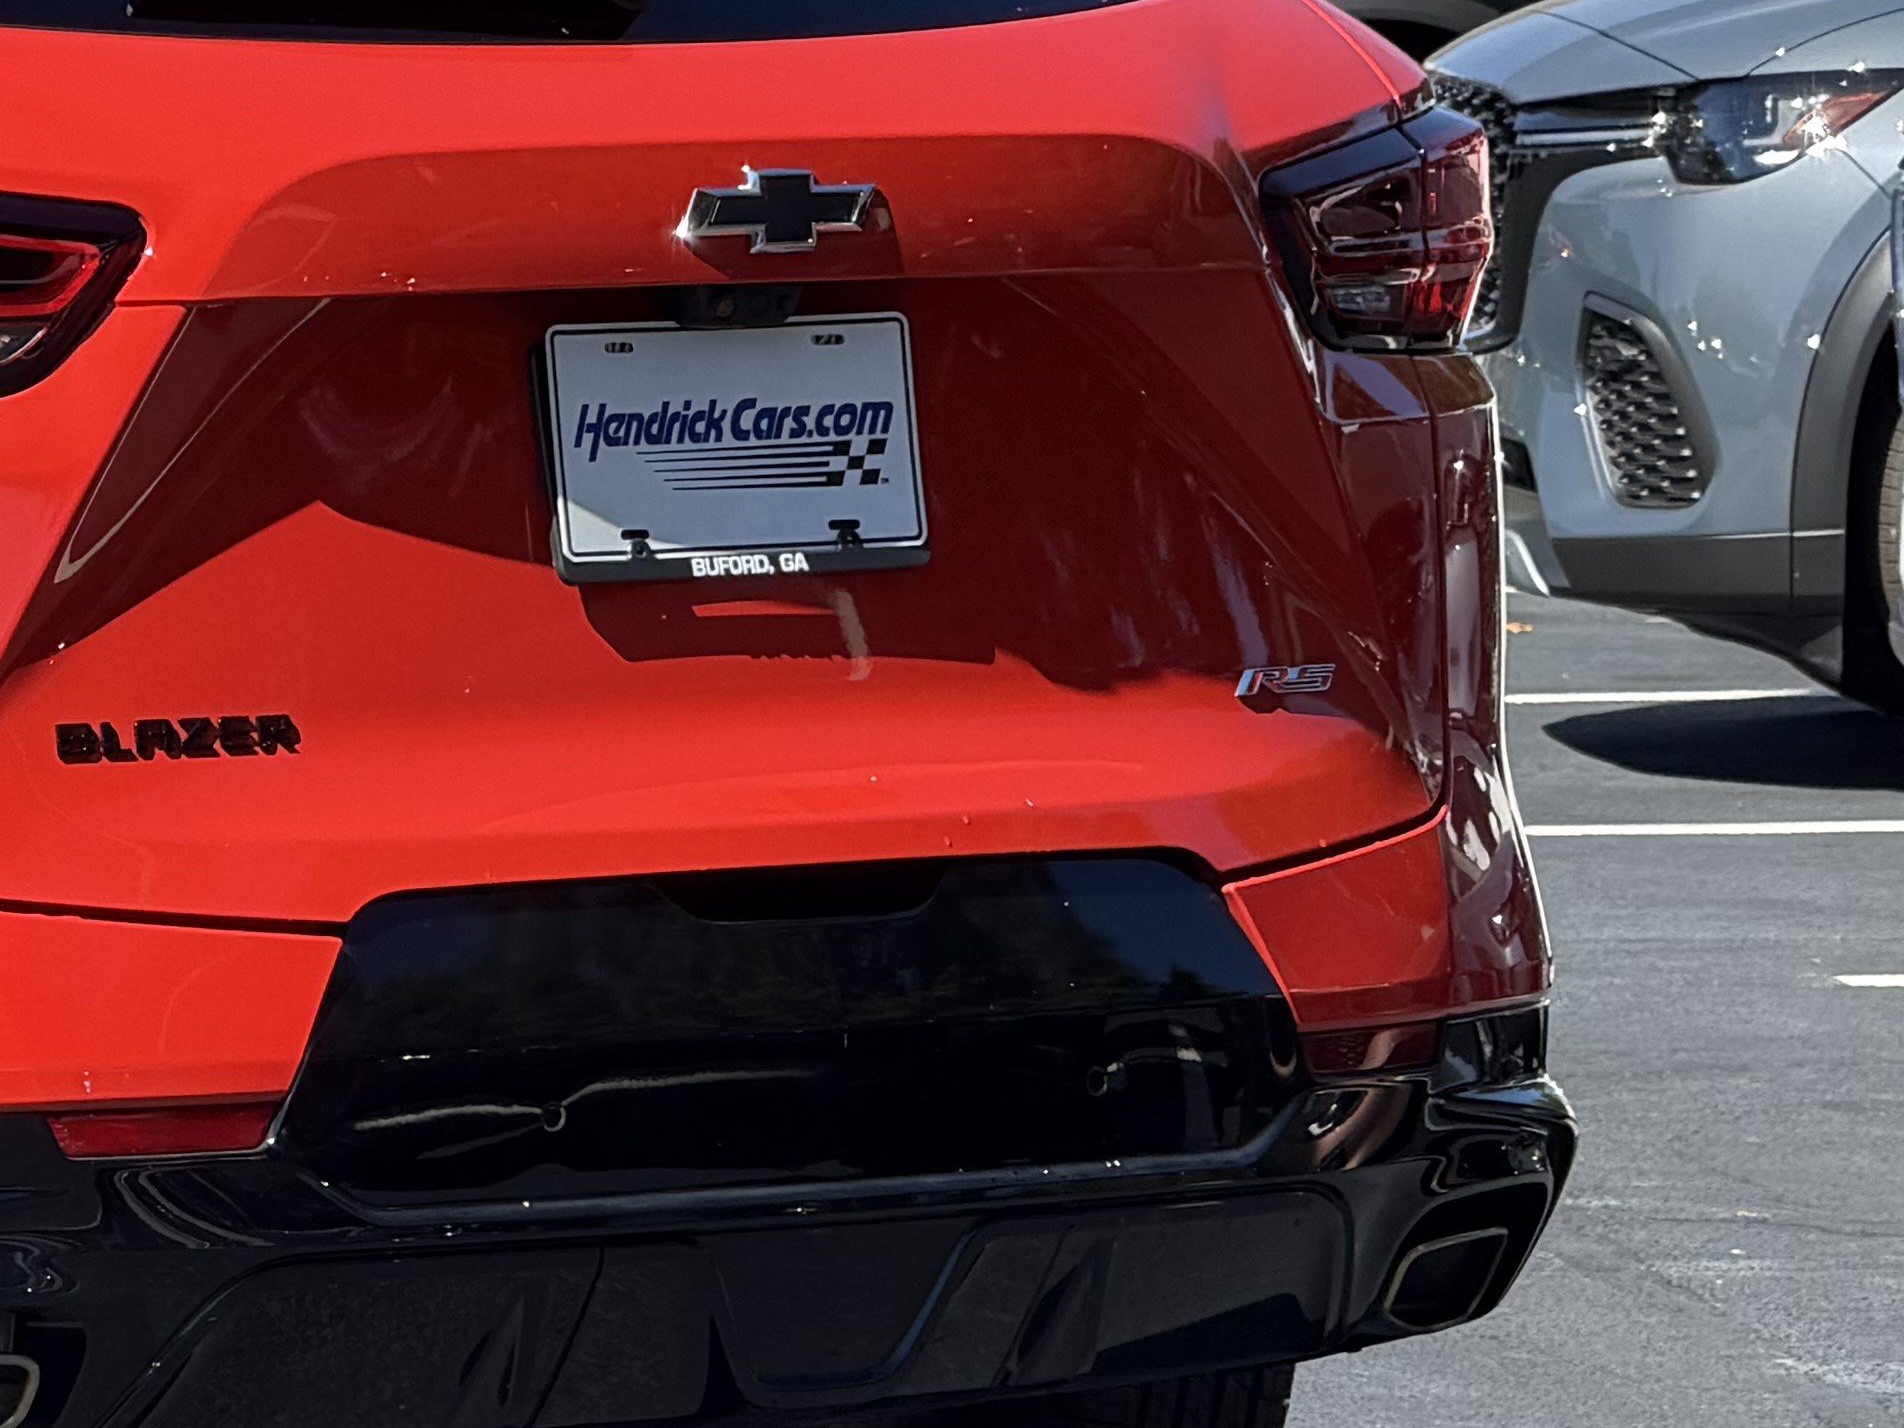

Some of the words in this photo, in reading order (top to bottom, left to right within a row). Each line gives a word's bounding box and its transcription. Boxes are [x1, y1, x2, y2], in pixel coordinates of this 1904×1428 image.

[573, 397, 894, 462] HendrickCars.com
[691, 553, 774, 578] BUFORD,
[779, 552, 810, 574] GA
[1234, 663, 1336, 698] RS
[55, 713, 302, 765] BLAZER
